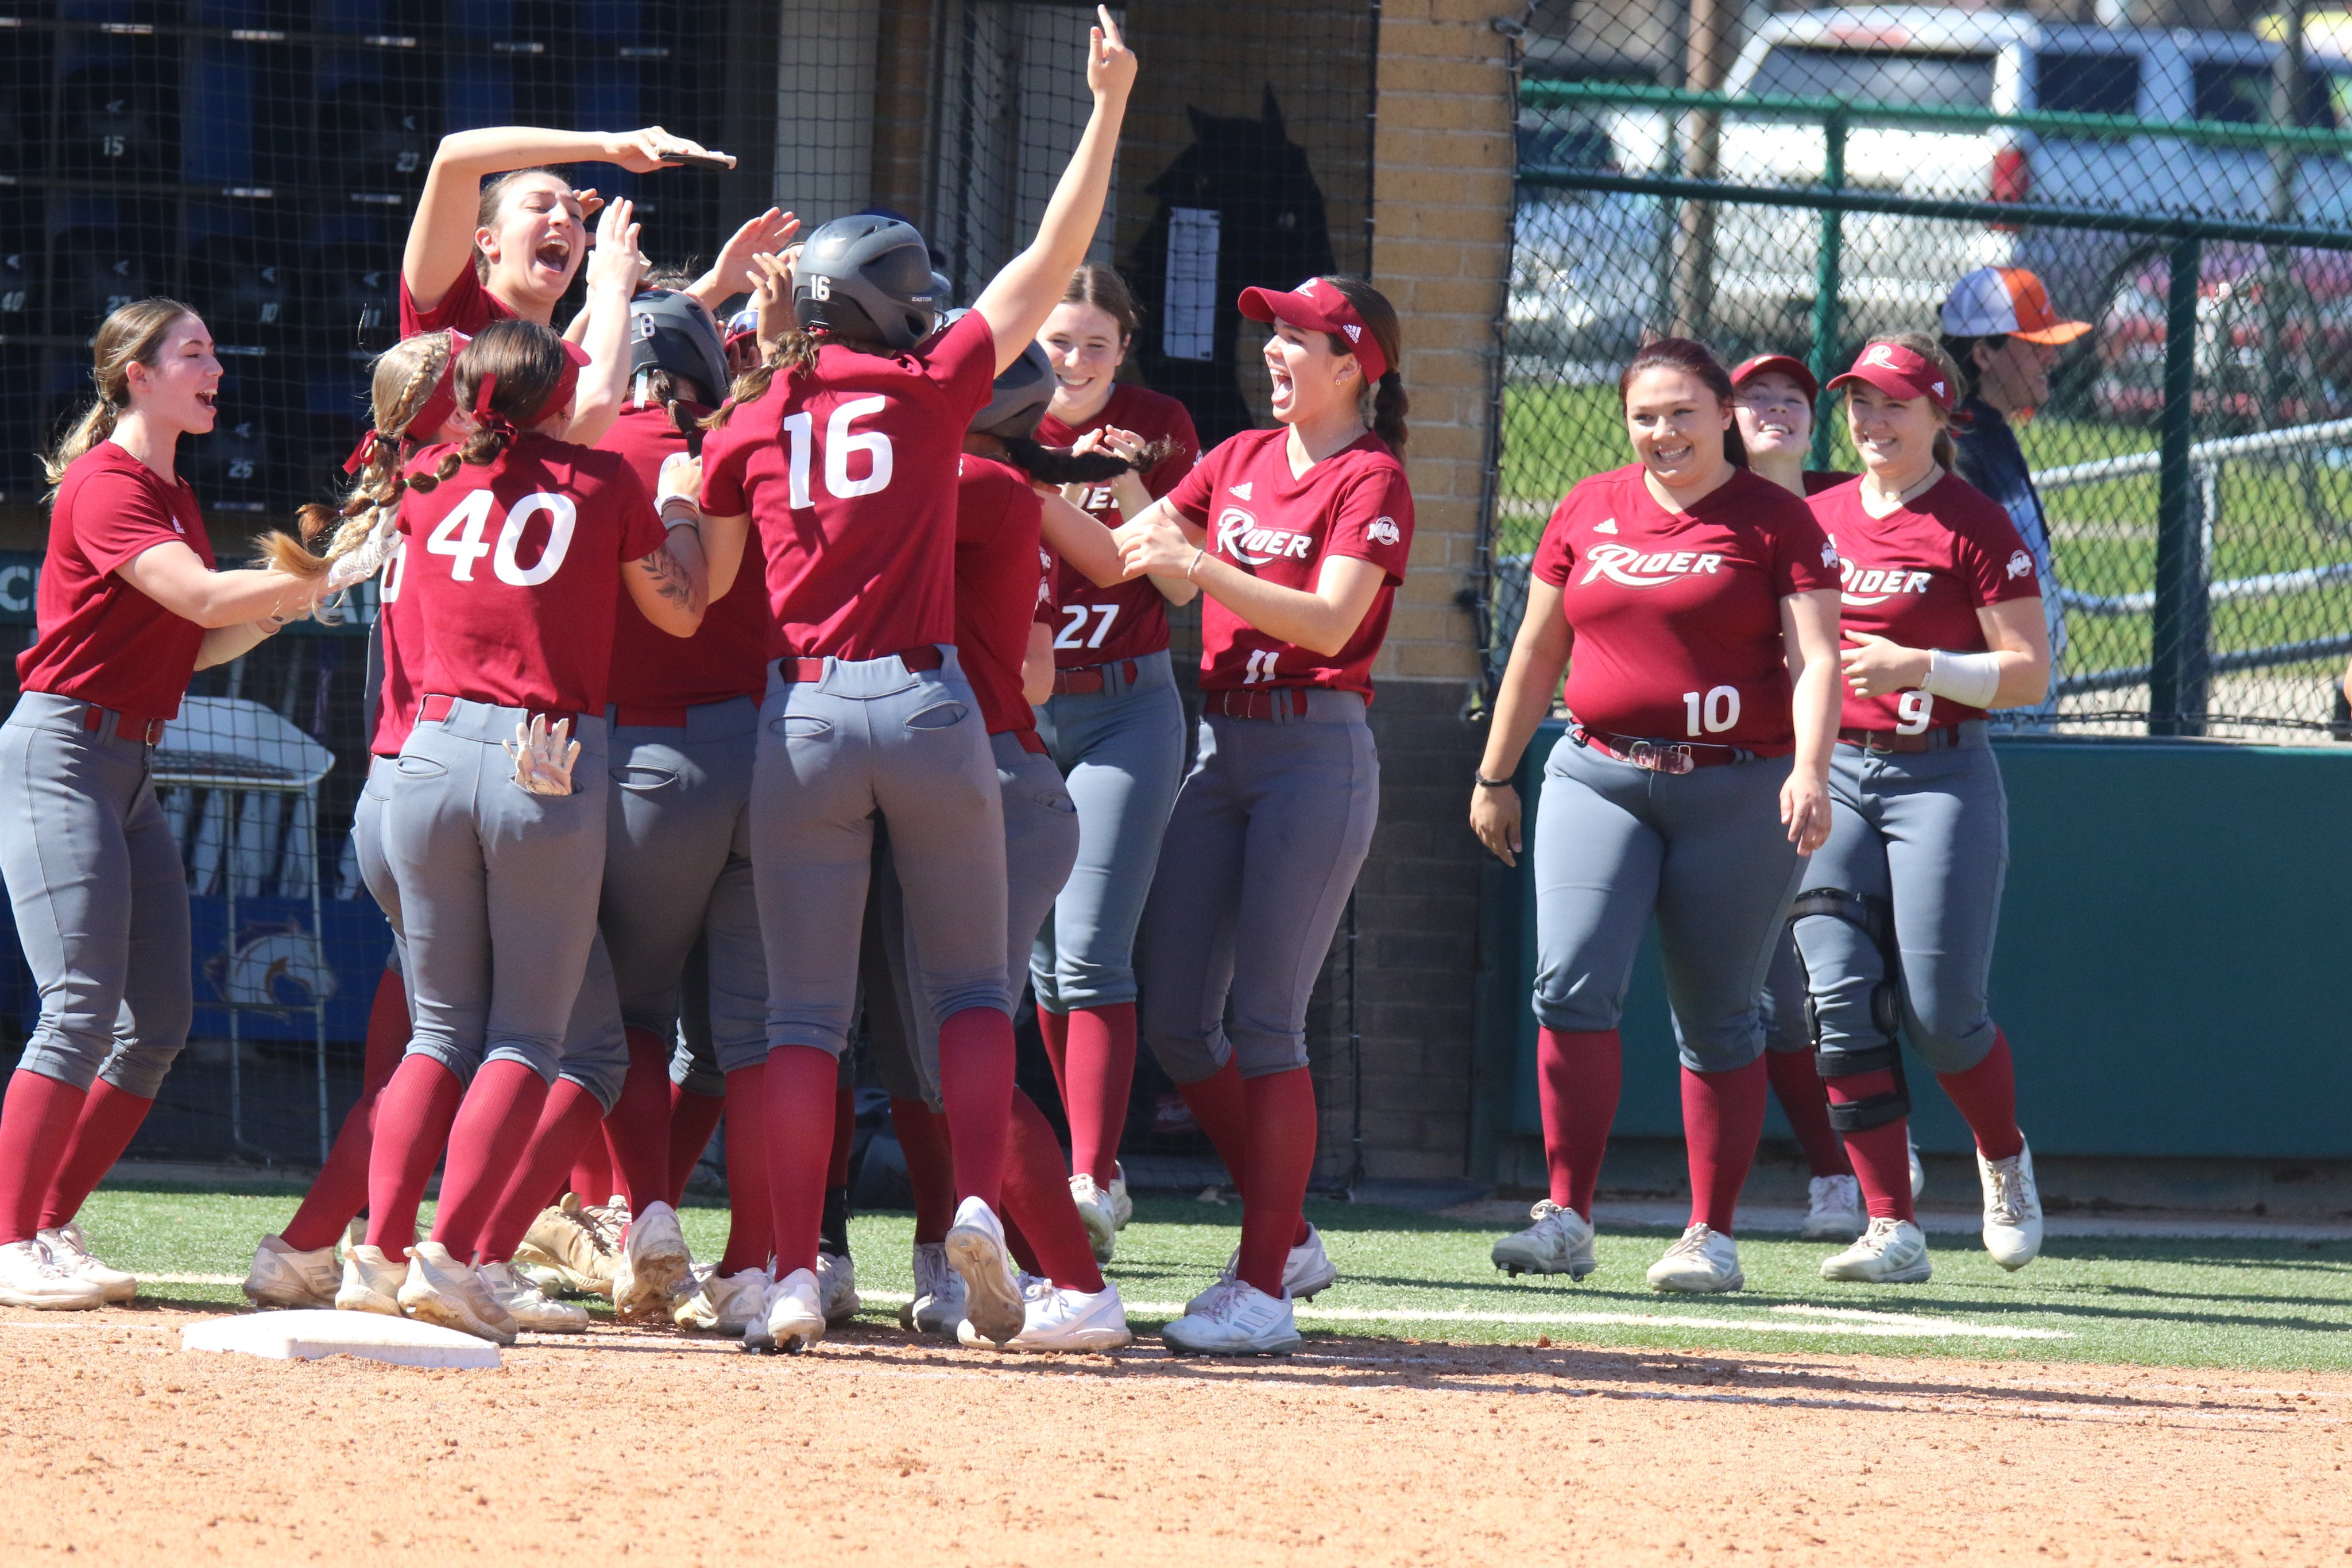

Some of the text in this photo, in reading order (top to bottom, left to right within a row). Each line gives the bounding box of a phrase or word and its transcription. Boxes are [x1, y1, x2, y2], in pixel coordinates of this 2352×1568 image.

[103, 135, 125, 156] 15
[810, 274, 830, 301] 16
[640, 313, 655, 337] 8
[1343, 324, 1359, 344] adidas
[1861, 345, 1900, 369] R
[783, 394, 893, 510] 16
[427, 489, 577, 586] 40
[1217, 508, 1313, 566] RIDER
[1579, 544, 1722, 586] RIDER
[1053, 604, 1120, 649] 27
[1243, 649, 1280, 684] 11
[1682, 684, 1741, 737] 10
[1895, 690, 1934, 735] 9
